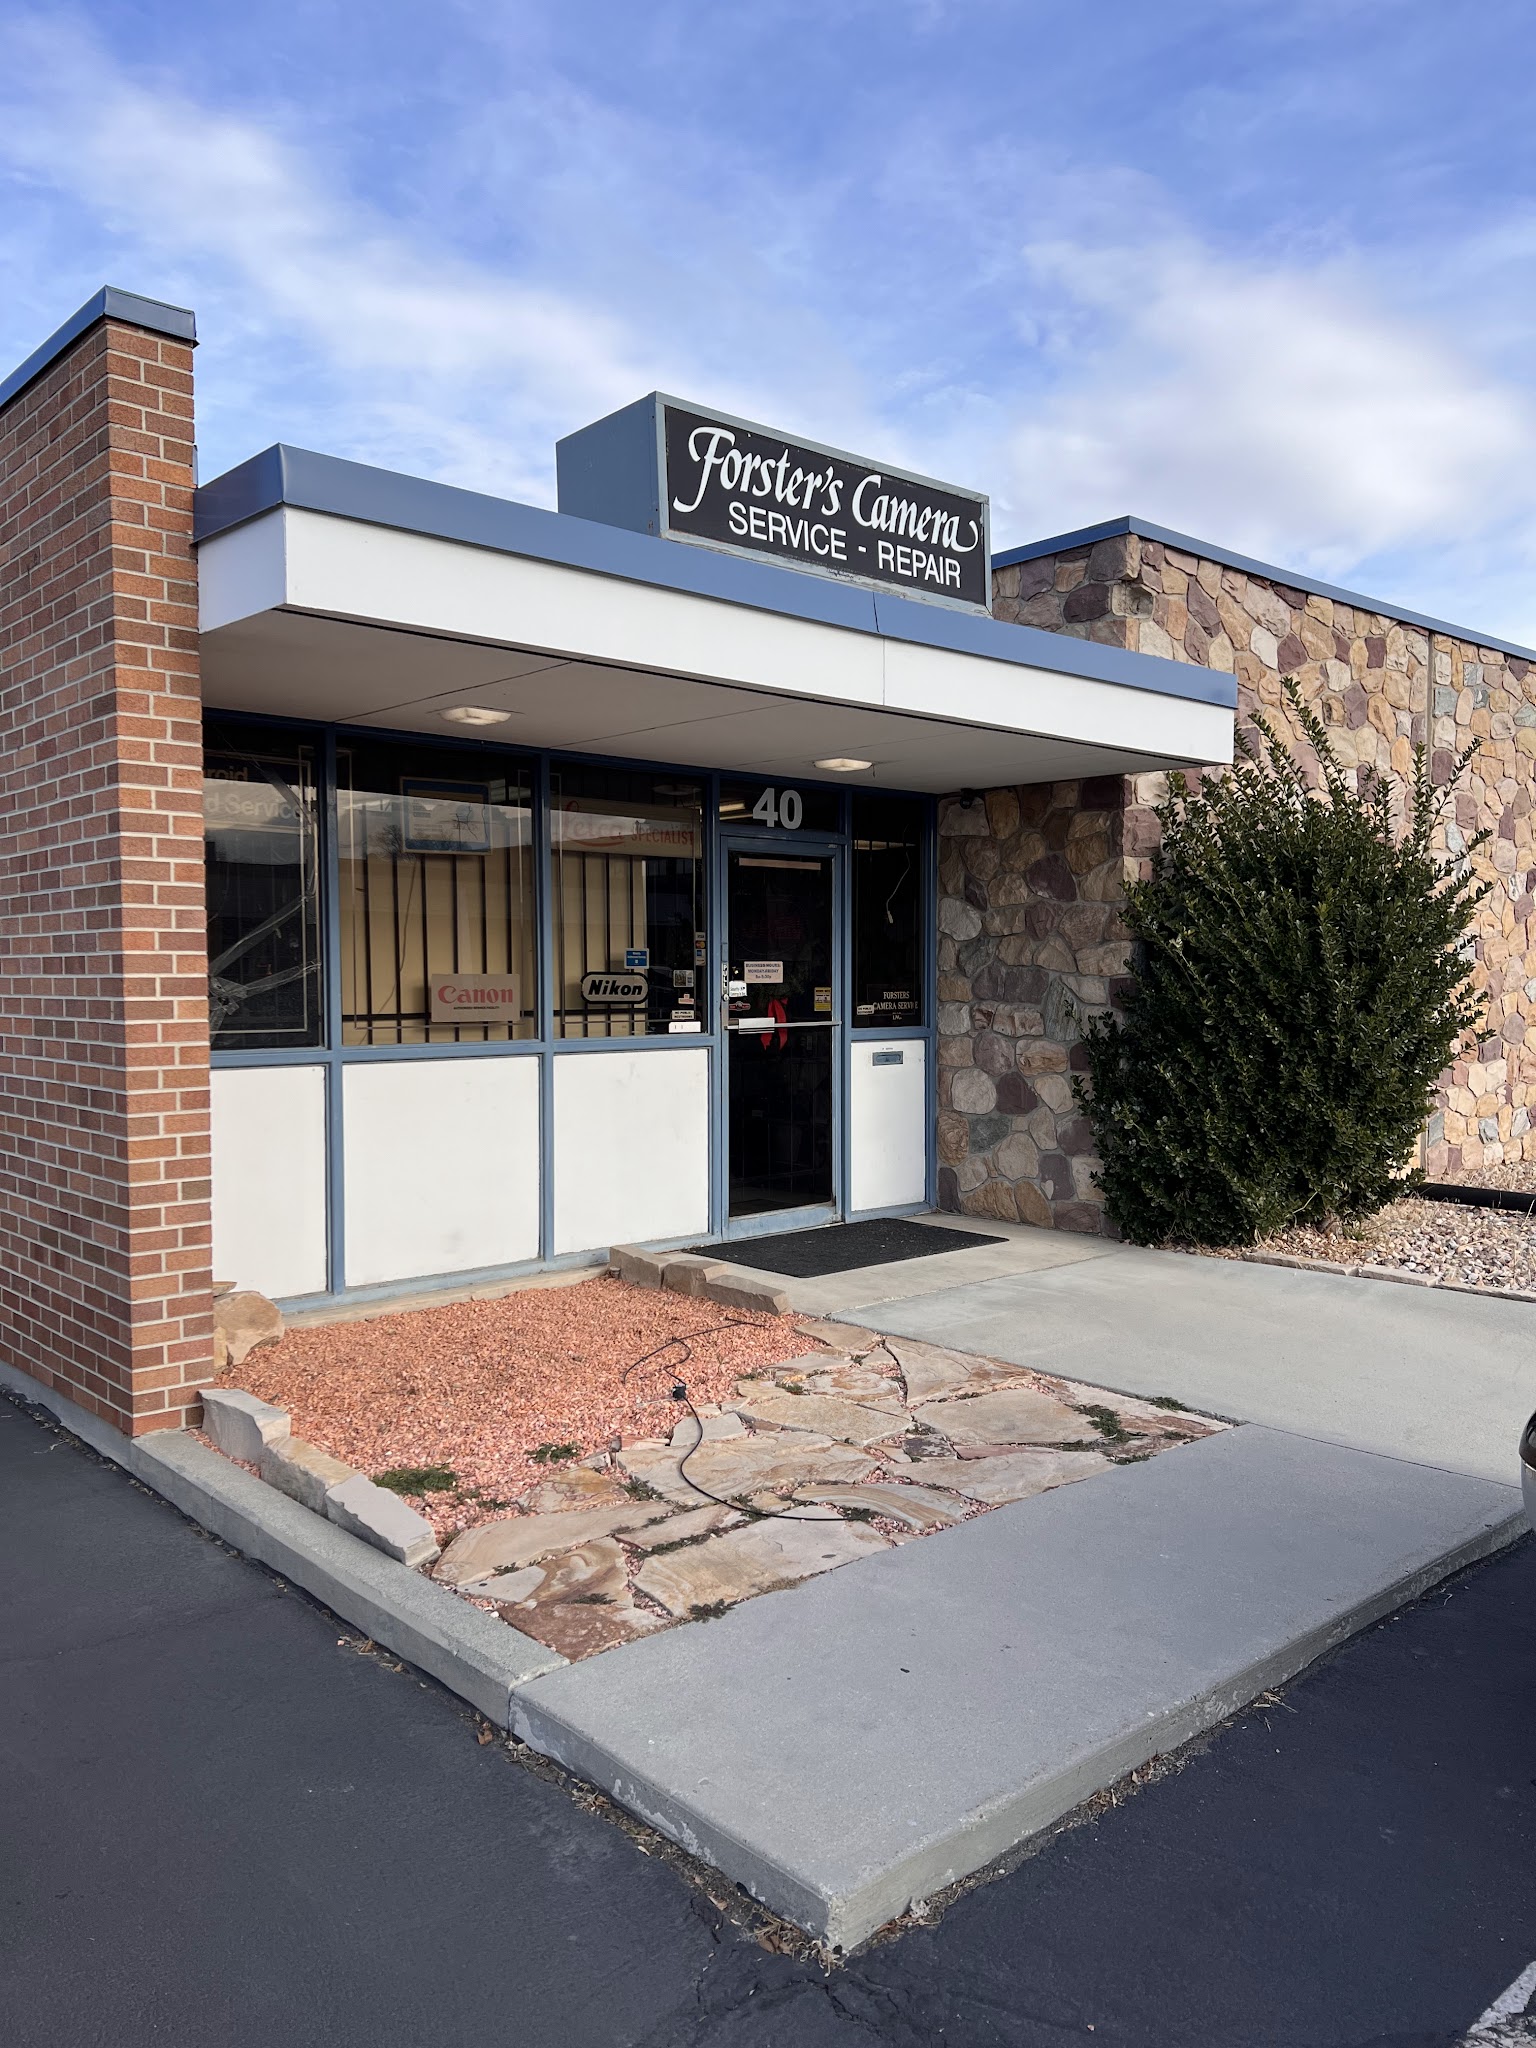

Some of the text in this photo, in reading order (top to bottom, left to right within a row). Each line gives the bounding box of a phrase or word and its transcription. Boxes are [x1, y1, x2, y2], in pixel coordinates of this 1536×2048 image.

[673, 426, 979, 553] Forster's Camera
[728, 501, 848, 561] SERVICE
[877, 540, 961, 589] REPAIR
[752, 787, 803, 830] 40
[631, 826, 695, 846] SPECIALIST
[438, 985, 513, 1004] Canon
[588, 979, 643, 996] Nikon
[873, 1001, 897, 1010] CAMERA
